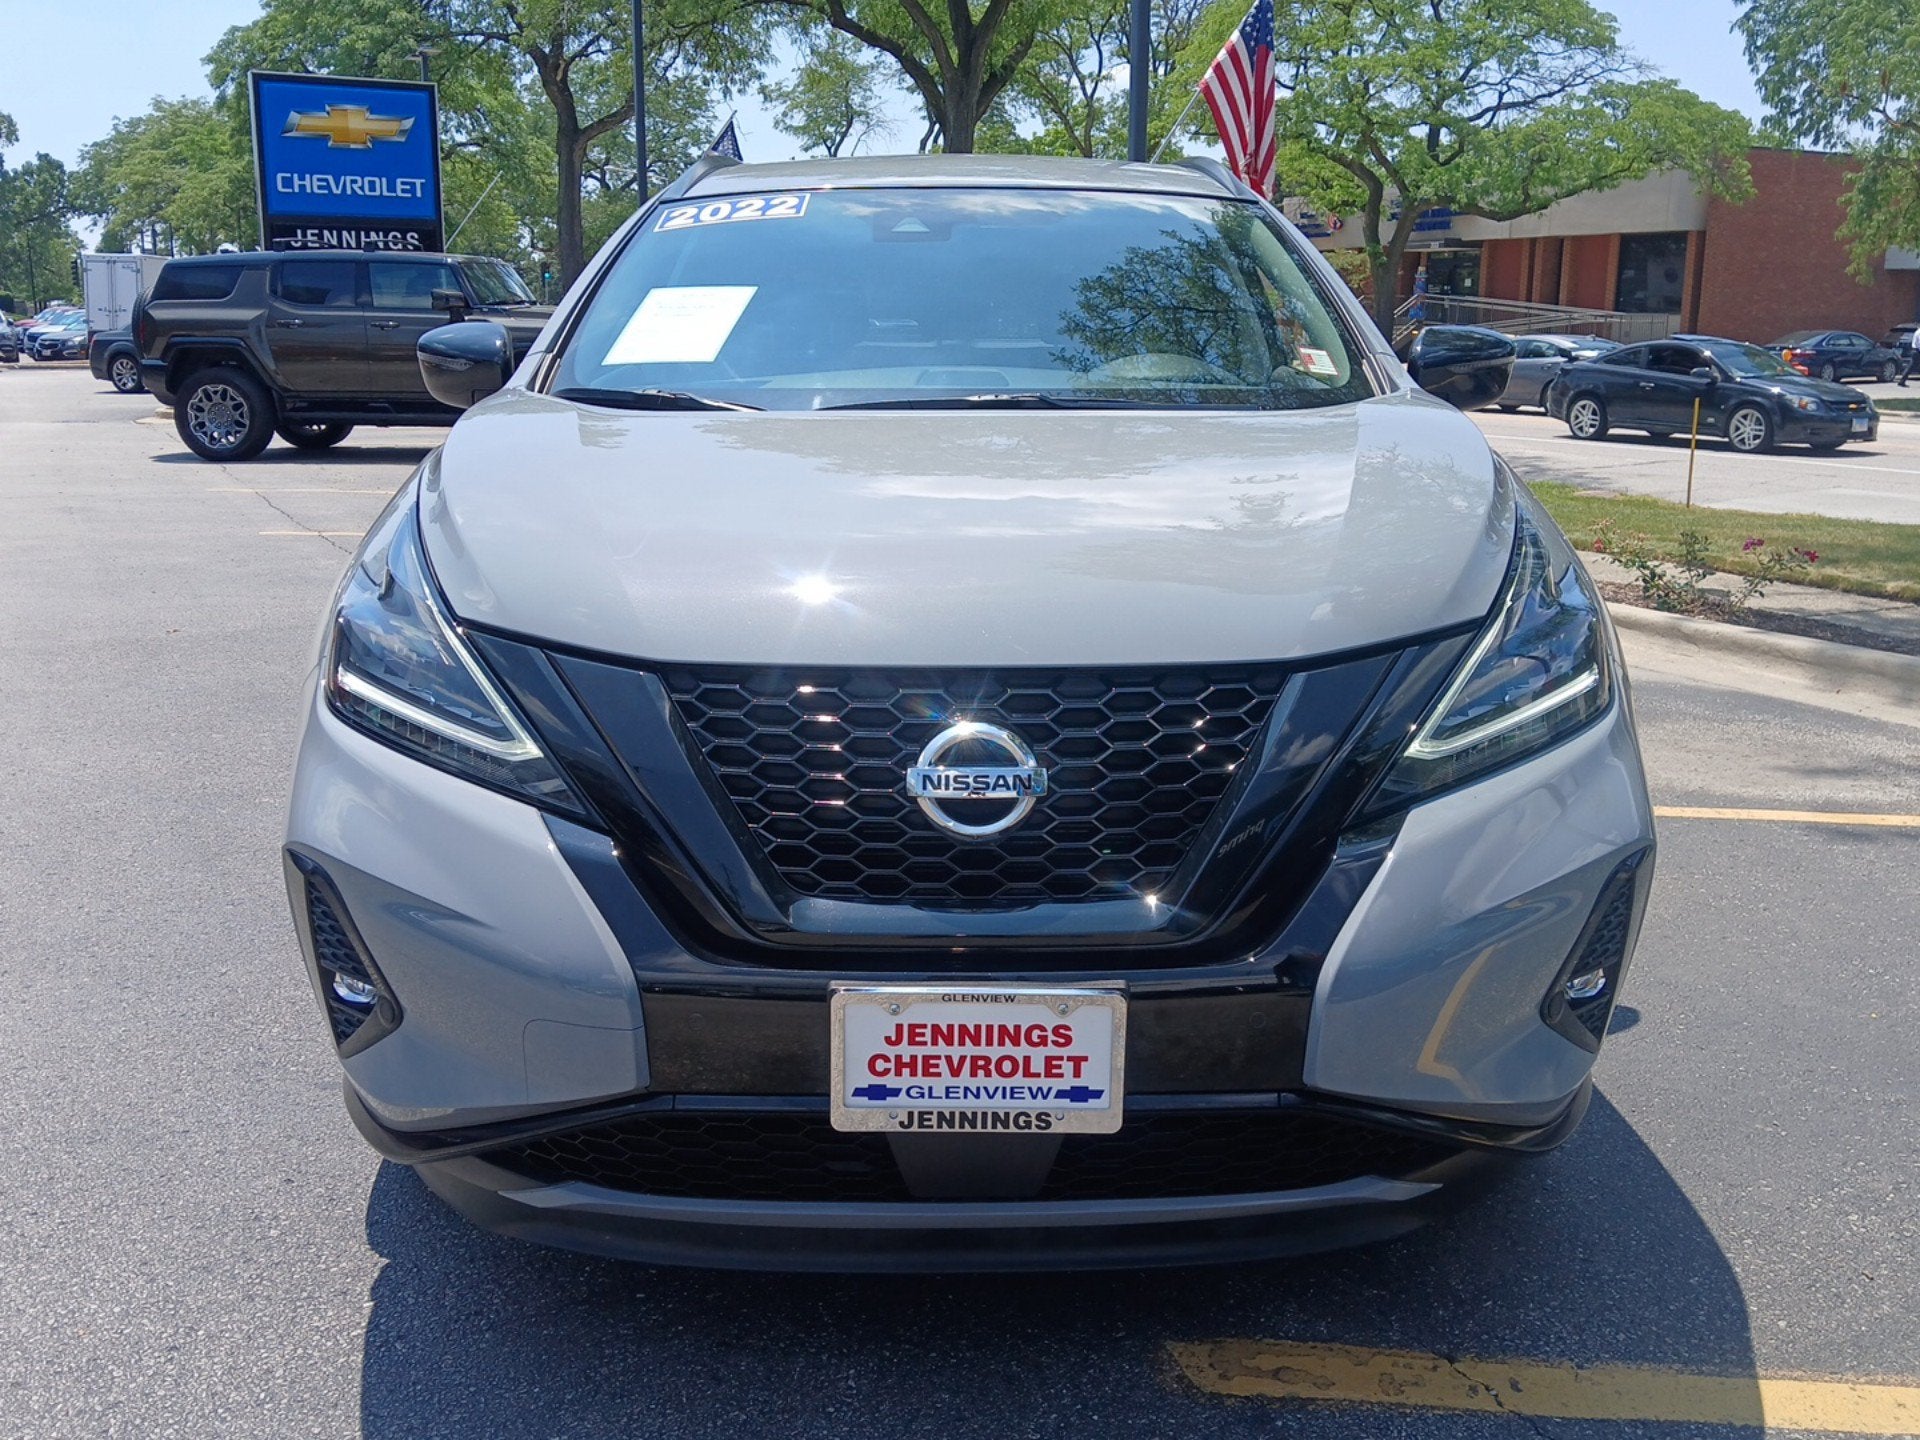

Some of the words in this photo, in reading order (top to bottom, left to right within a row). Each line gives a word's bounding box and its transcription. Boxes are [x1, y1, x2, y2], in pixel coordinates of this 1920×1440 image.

[276, 172, 426, 198] CHEVROLET
[662, 196, 800, 229] 2022
[290, 228, 420, 250] JENNINGS
[922, 774, 1032, 792] NISSAN
[942, 993, 1017, 1004] GLENVIEW
[884, 1023, 1073, 1047] JENNINGS
[867, 1054, 1089, 1079] CHEVROLET
[905, 1085, 1053, 1100] GLENVIEW
[899, 1110, 1053, 1131] JENNINGS
